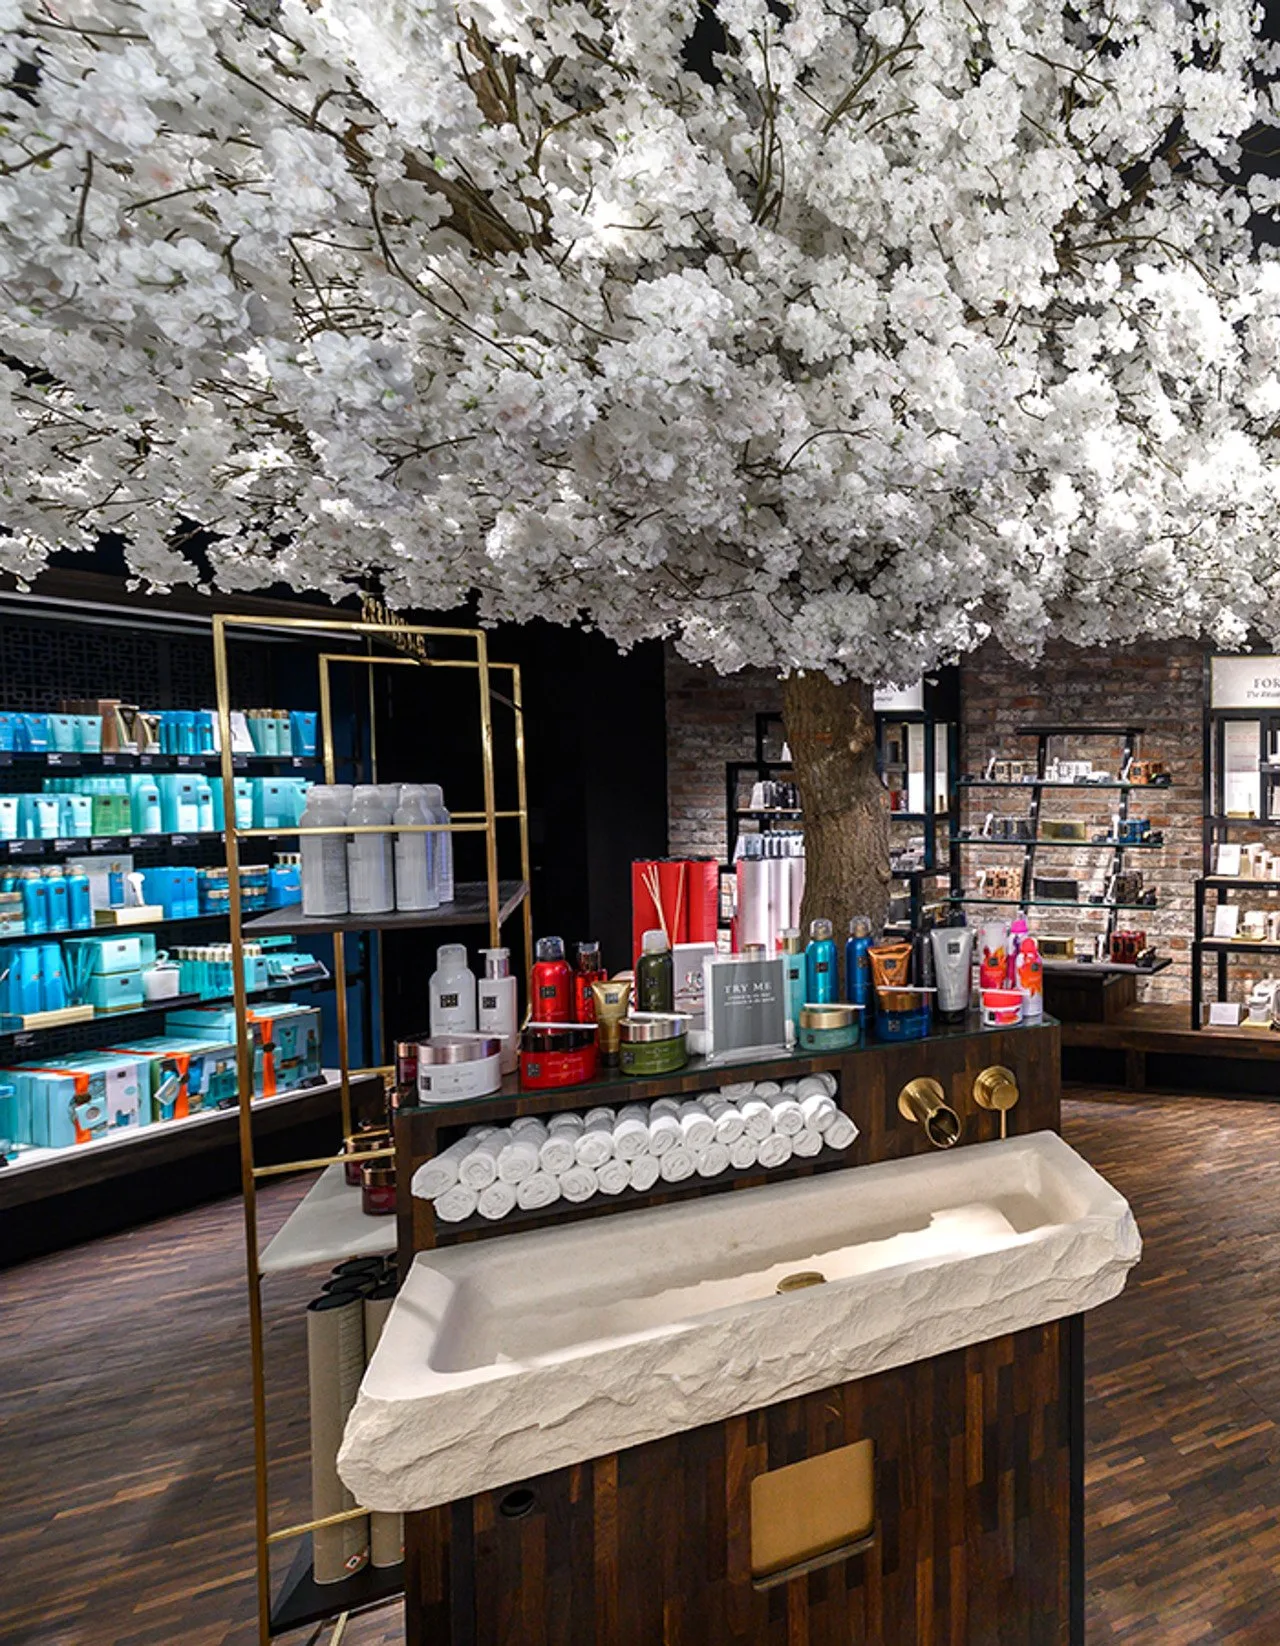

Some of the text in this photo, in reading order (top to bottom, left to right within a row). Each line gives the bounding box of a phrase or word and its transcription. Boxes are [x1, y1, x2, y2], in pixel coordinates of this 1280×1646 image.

[1253, 678, 1280, 689] FOR
[724, 981, 772, 994] TRY ME
